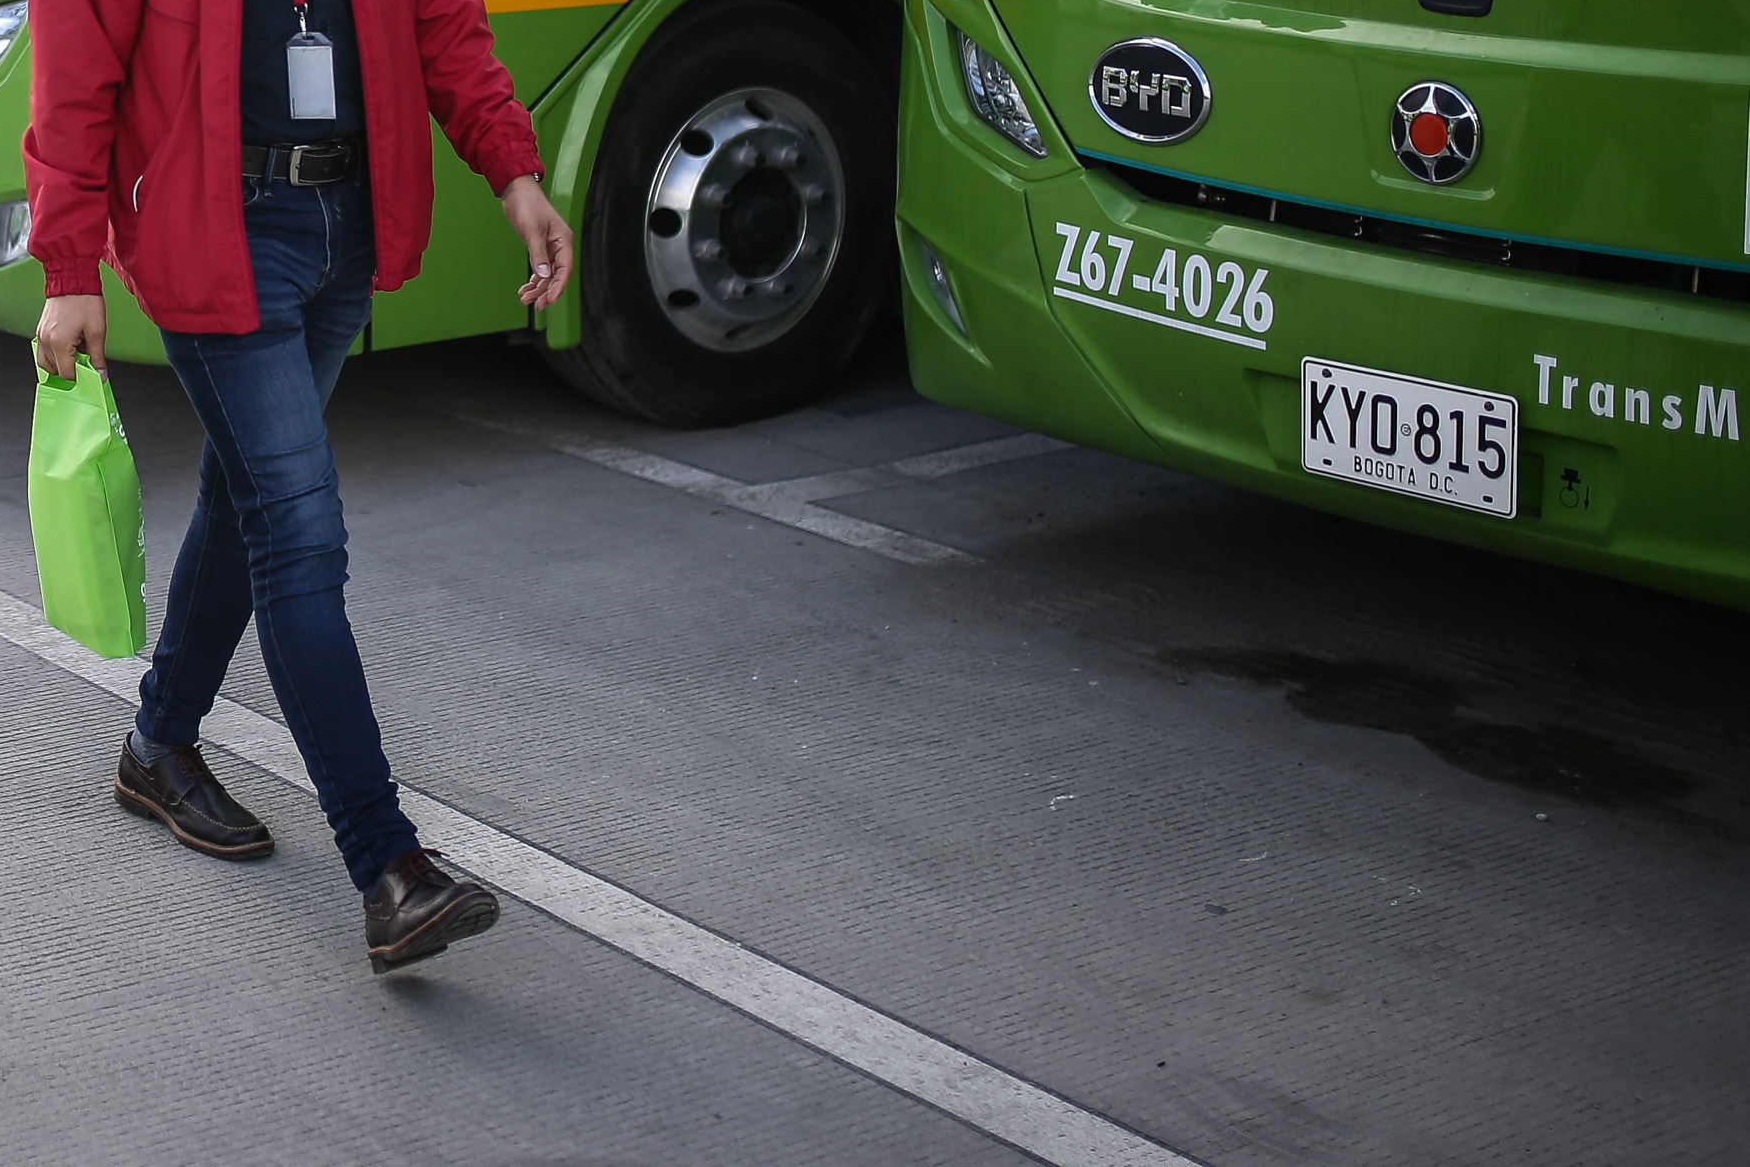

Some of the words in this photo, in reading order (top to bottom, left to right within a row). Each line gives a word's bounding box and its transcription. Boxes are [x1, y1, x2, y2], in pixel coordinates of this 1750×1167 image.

[1102, 65, 1191, 119] BYD
[1055, 222, 1274, 333] Z67-4026
[1533, 353, 1740, 441] TransM
[1354, 455, 1416, 486] BOGOTA
[1429, 472, 1458, 496] D.C.
[1414, 403, 1507, 479] 815
